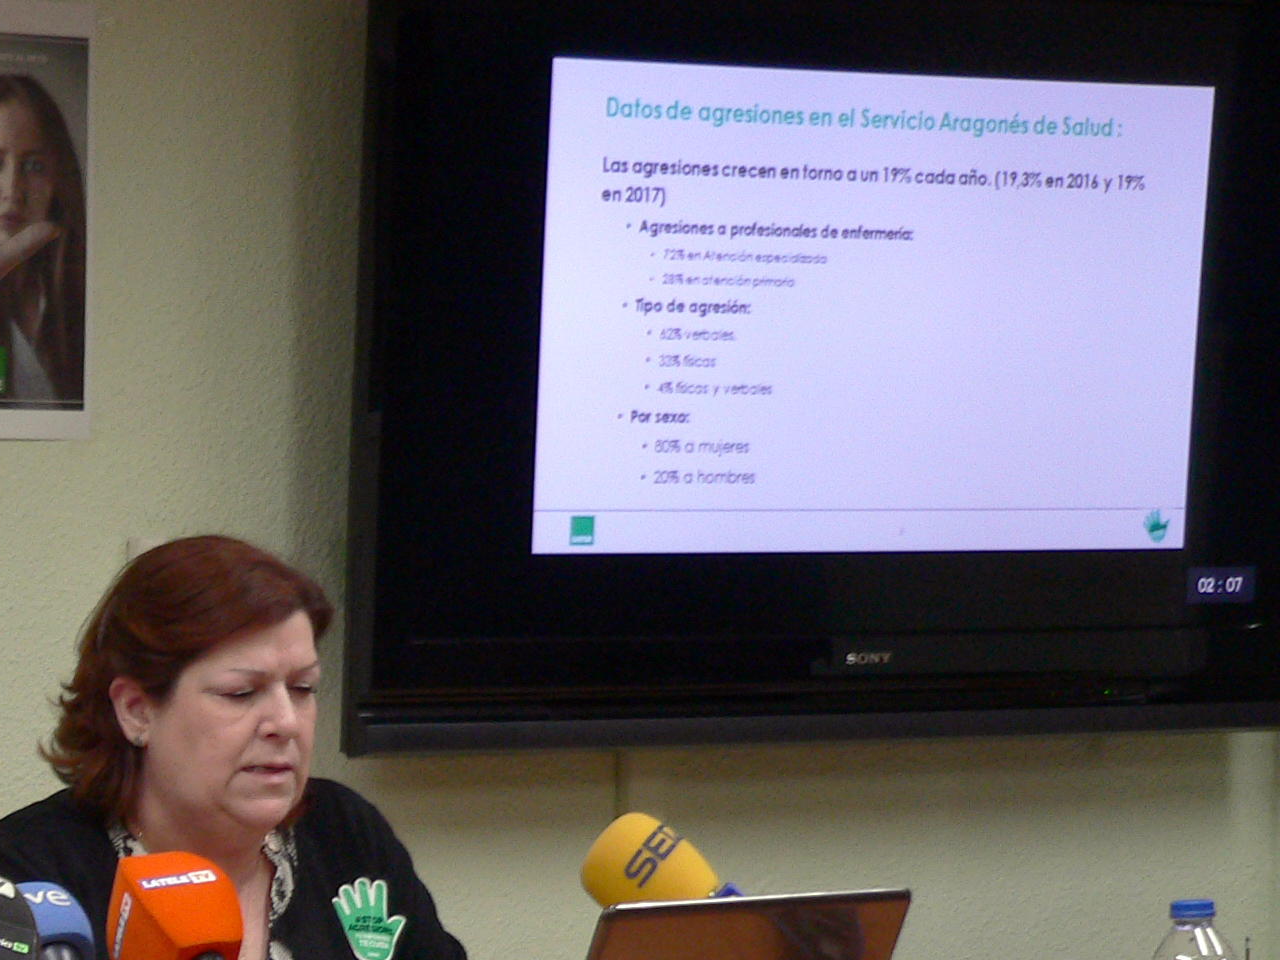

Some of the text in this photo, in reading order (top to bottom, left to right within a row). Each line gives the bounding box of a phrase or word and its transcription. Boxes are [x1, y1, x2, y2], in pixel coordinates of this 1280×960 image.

[606, 97, 662, 119] Datos
[666, 100, 693, 121] de
[698, 103, 804, 127] agresiones
[809, 109, 832, 127] en
[838, 107, 855, 128] el
[860, 108, 936, 131] Servicio
[938, 111, 1029, 138] Aragonés
[1033, 114, 1058, 135] de
[603, 156, 629, 174] Las
[632, 159, 719, 178] agresiones
[722, 164, 776, 179] crecen
[780, 166, 799, 180] en
[802, 163, 843, 182] torno
[847, 168, 857, 182] a
[860, 169, 879, 182] un
[883, 166, 912, 184] 19%
[914, 169, 955, 185] cada
[994, 170, 1042, 190] (19,3%
[1045, 175, 1064, 188] en
[1066, 173, 1099, 190] 2016
[1103, 178, 1112, 194] y
[1117, 174, 1146, 191] 19%
[601, 186, 666, 208] en 2017)
[639, 219, 715, 238] Agresiones
[717, 224, 727, 236] a
[729, 222, 818, 241] profesionales
[821, 224, 839, 239] de
[687, 252, 702, 262] en
[686, 275, 701, 286] en
[635, 298, 663, 316] Tipo
[666, 300, 685, 313] de
[713, 384, 720, 398] y
[630, 409, 652, 424] Por
[654, 439, 750, 458] 80% a mujeres
[653, 469, 756, 485] 20% a hombres
[845, 651, 892, 666] SONY
